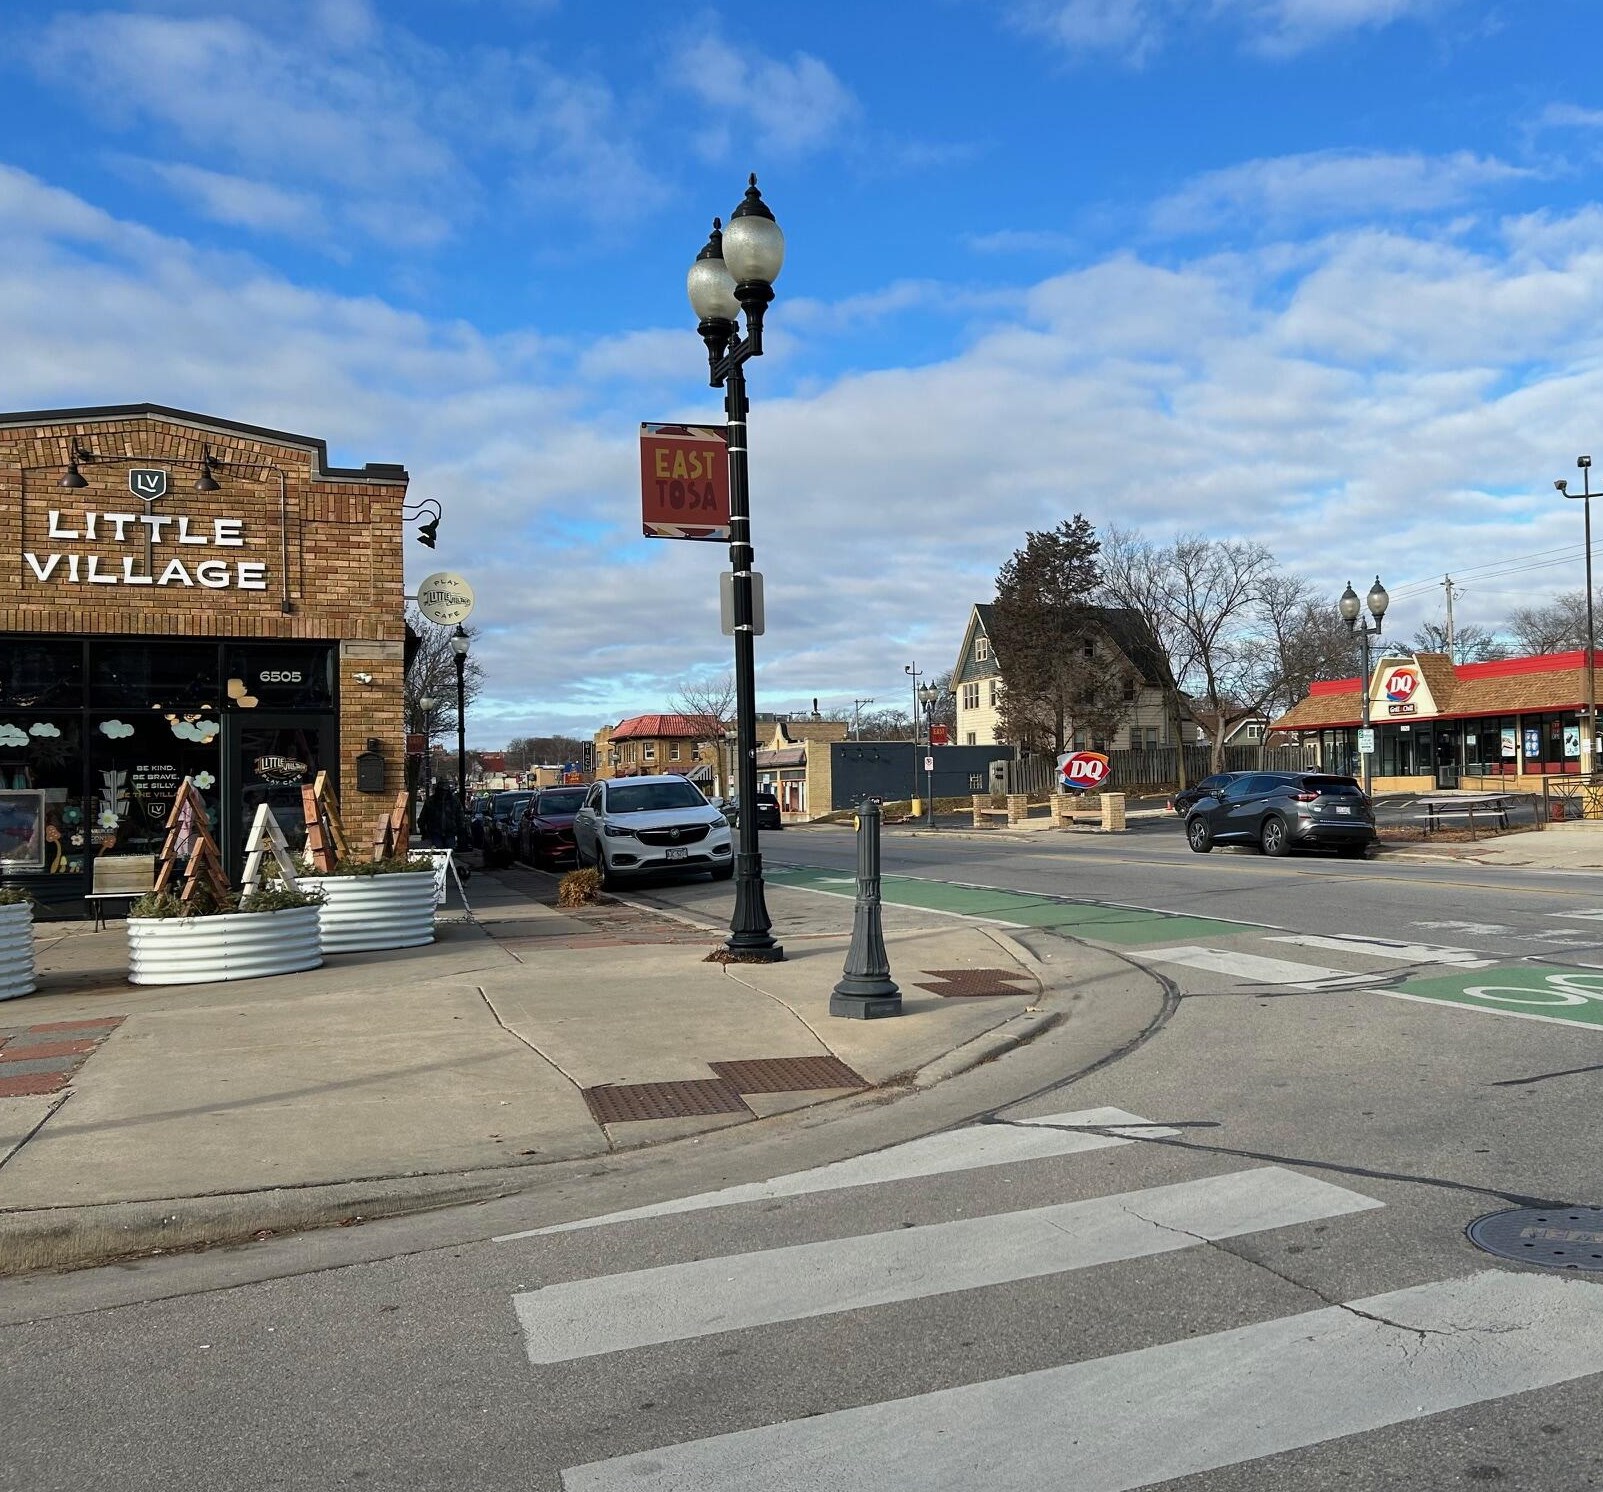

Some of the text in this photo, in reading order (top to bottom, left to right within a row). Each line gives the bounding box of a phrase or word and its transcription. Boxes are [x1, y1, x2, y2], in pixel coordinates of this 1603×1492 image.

[655, 448, 716, 479] EAST
[137, 474, 160, 493] LV
[655, 480, 718, 511] TOSA
[48, 510, 244, 547] LITTLE
[23, 552, 268, 590] VILLAGE
[433, 579, 459, 587] PLAY
[429, 591, 451, 604] LITTLE
[434, 610, 460, 619] CAFE
[259, 670, 302, 682] 6505
[1389, 674, 1413, 694] DQ
[260, 757, 284, 771] LITTLE
[1069, 760, 1103, 781] DQ
[261, 773, 303, 787] PLAY CAFE
[151, 805, 163, 815] LV
